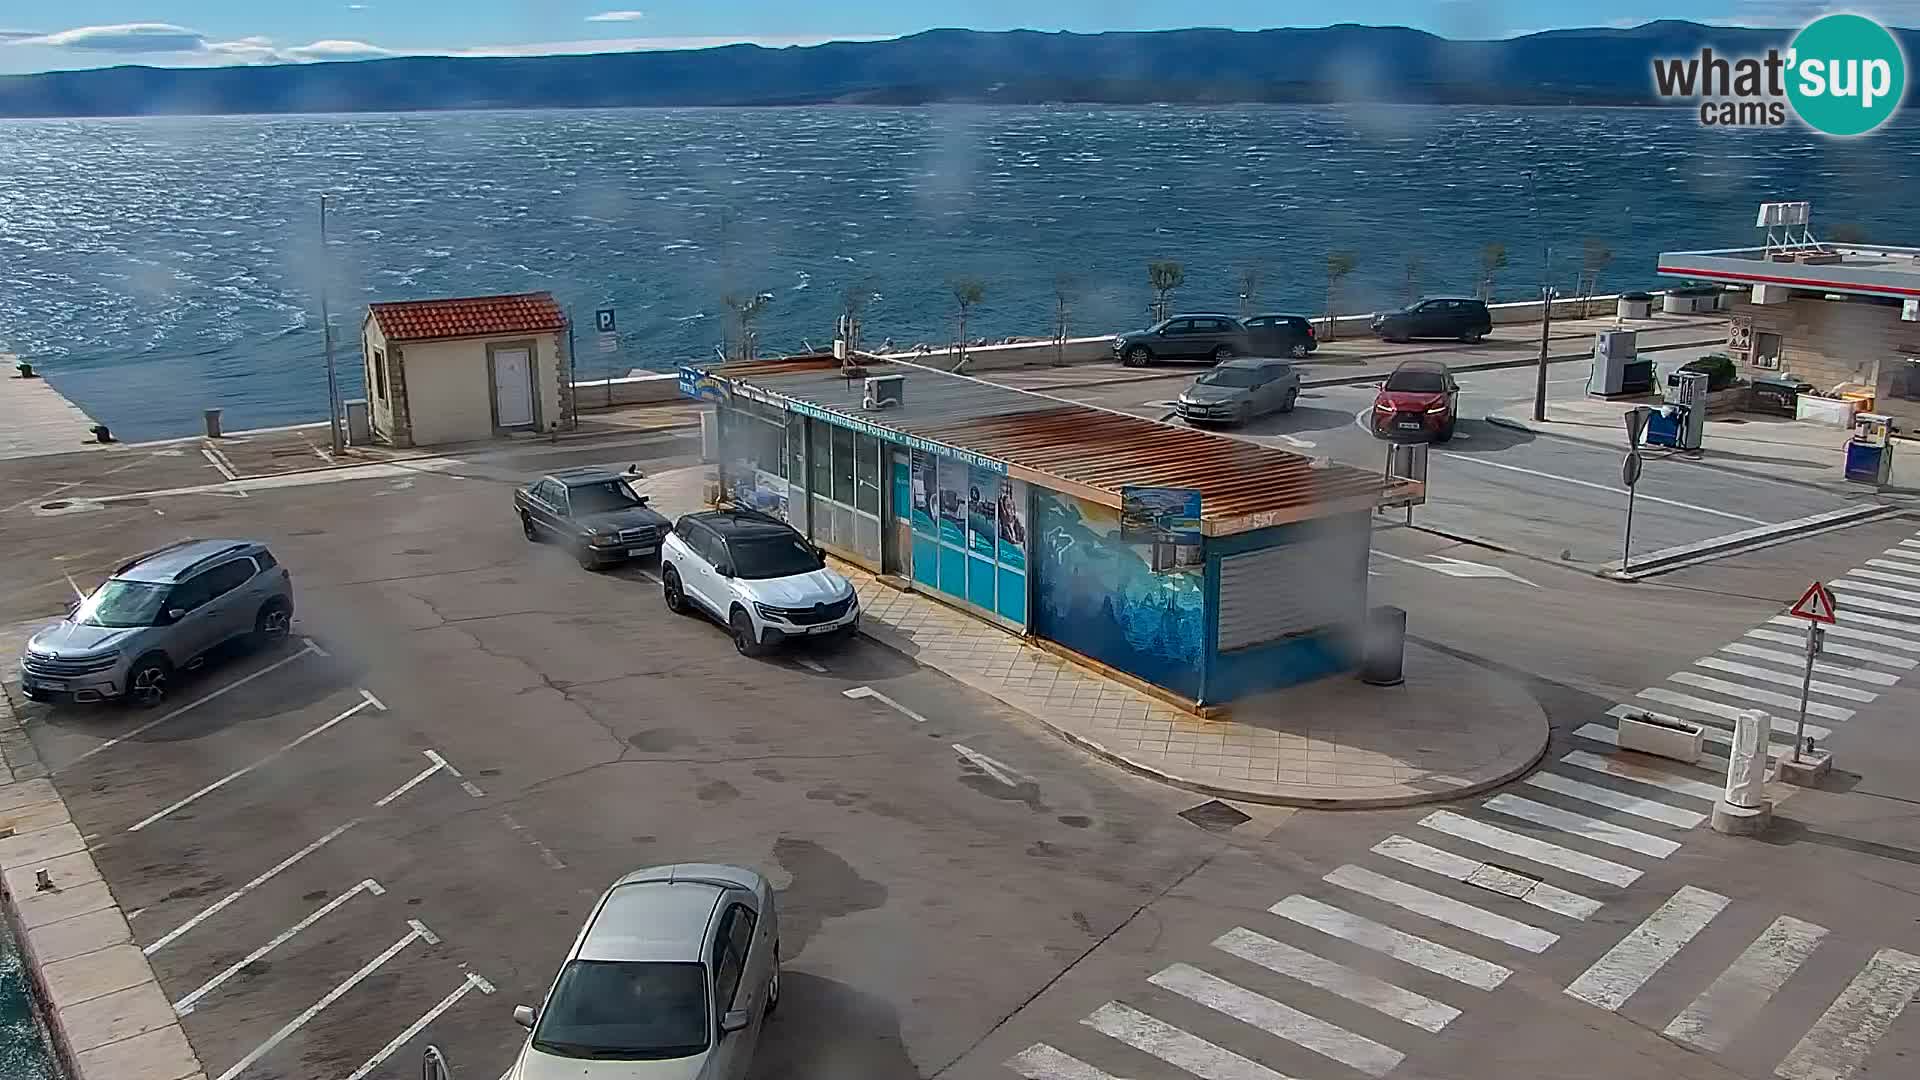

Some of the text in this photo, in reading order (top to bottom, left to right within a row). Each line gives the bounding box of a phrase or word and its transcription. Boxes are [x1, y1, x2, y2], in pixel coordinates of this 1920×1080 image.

[600, 312, 611, 329] P
[867, 426, 896, 441] POSTAJA
[905, 437, 919, 449] BUS
[920, 441, 950, 457] STATION
[952, 449, 977, 464] TICKET
[977, 458, 1003, 472] OFFICE
